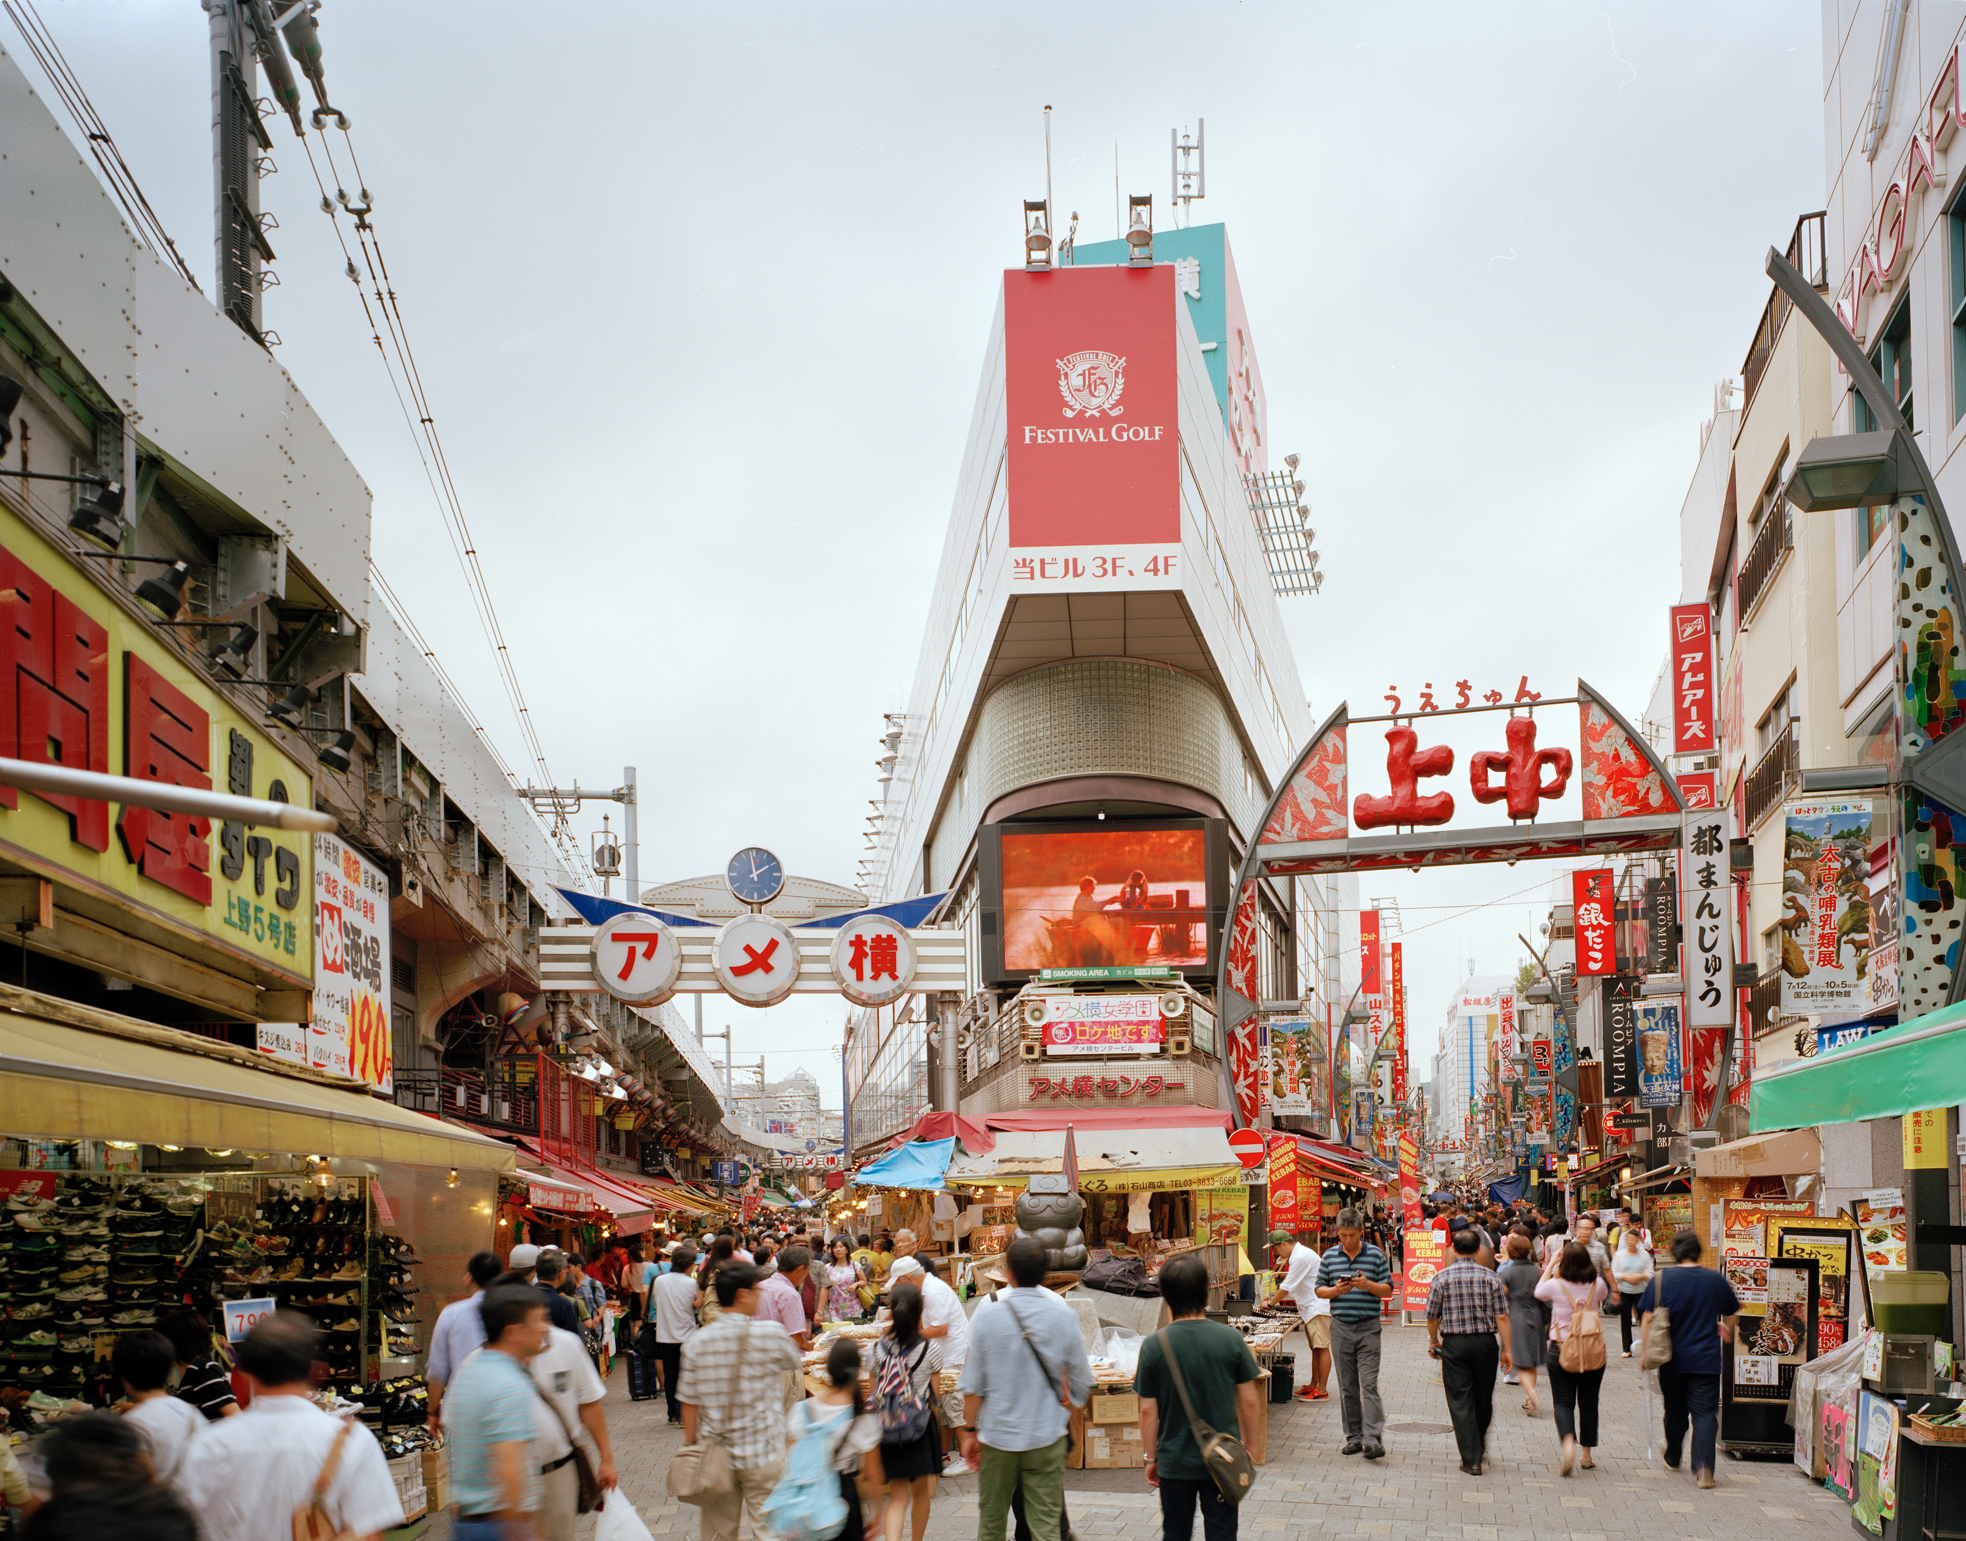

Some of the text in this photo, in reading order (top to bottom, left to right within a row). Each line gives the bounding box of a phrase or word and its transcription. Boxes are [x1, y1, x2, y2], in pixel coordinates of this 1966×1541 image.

[1837, 40, 1966, 373] NAGAF
[1023, 423, 1163, 444] FESTIVAL GOLF
[1384, 675, 1542, 714] うえちゅん
[1681, 652, 1706, 740] アドアーズ
[1353, 716, 1573, 831] 上中
[1689, 824, 1724, 1008] 都まんじゅう
[1816, 844, 1842, 969] 太古の哺乳類展
[223, 889, 297, 956] 上野5号店
[1657, 895, 1667, 962] ROOMPIA
[1577, 902, 1612, 971] 銀だこ
[611, 933, 899, 981] アメ横
[1052, 970, 1088, 978] SMOKING
[1088, 969, 1109, 977] AREA
[1463, 996, 1491, 1006] 松坂屋
[1794, 990, 1852, 999] 国立科学博物館
[1054, 1000, 1152, 1019] アメ横女学園
[1076, 1024, 1153, 1040] ロケ地です
[1625, 1002, 1633, 1046] ルームピア
[1072, 1044, 1135, 1052] アメ横センタービル
[1612, 1002, 1627, 1094] ROOMPIA
[1029, 1075, 1184, 1099] アメ横センター
[1912, 1112, 1923, 1154] 販売に注意
[1270, 1140, 1296, 1160] JUMBO
[784, 1156, 836, 1166] アメ横
[1271, 1152, 1296, 1170] DONER
[1270, 1162, 1296, 1182] KEBAB
[1297, 1177, 1320, 1186] EBAB
[1298, 1221, 1317, 1229] 500
[1405, 1232, 1433, 1241] JUMBO
[1409, 1240, 1436, 1249] DONER
[1415, 1249, 1442, 1257] KEBAB
[1818, 1263, 1840, 1274] がな
